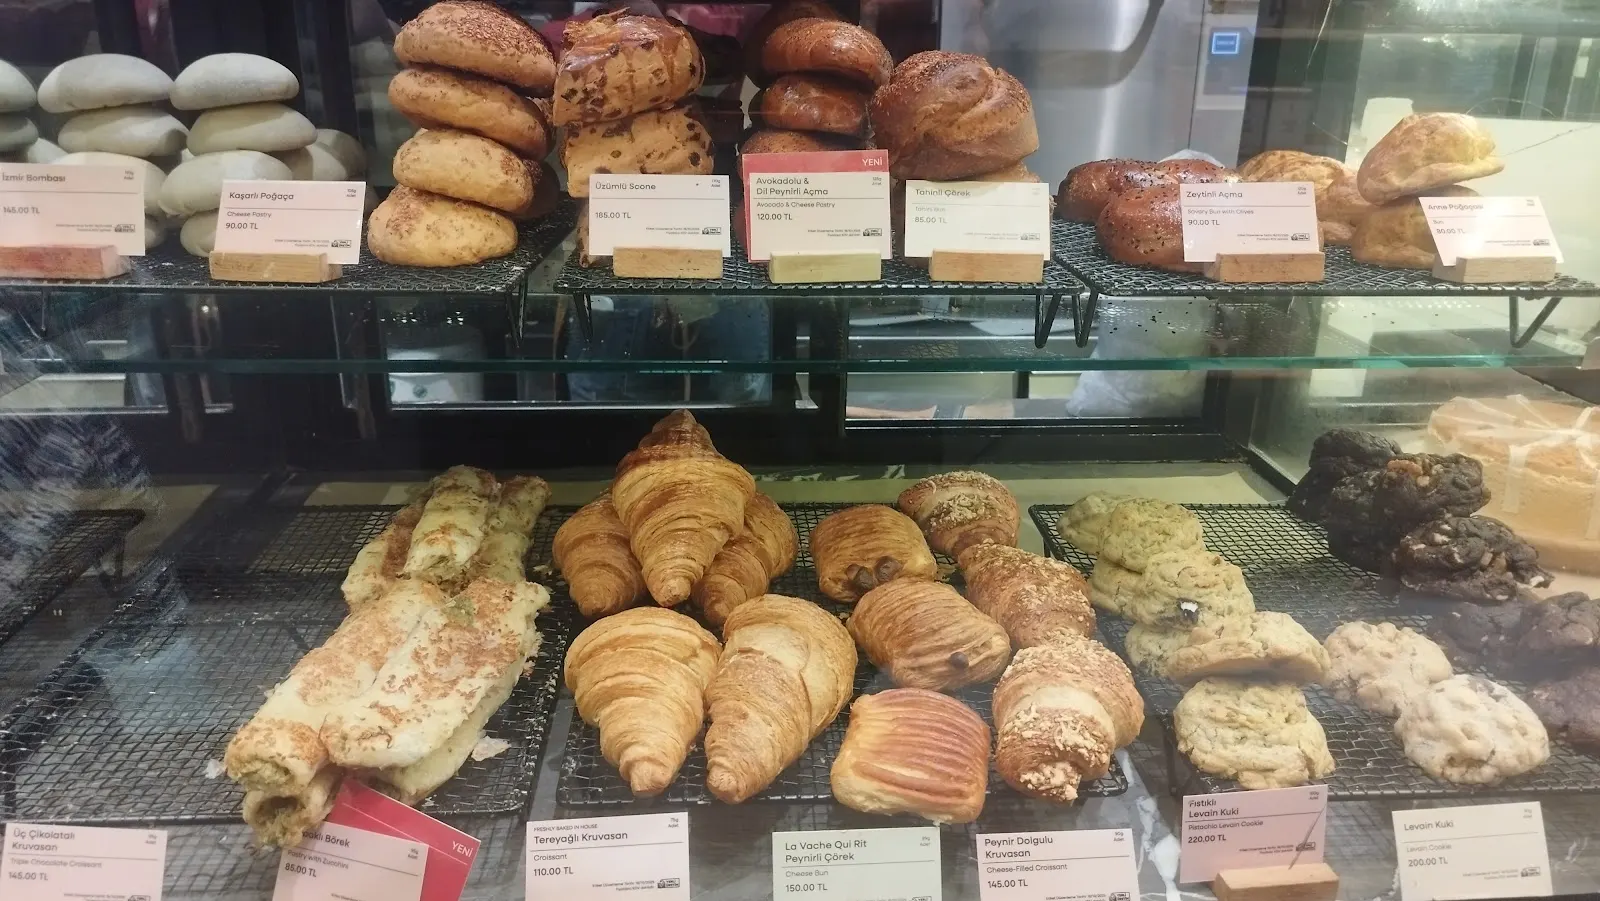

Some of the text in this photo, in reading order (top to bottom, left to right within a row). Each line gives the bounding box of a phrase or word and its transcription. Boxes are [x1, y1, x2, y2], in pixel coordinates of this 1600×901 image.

[862, 157, 882, 166] YENİ
[26, 174, 66, 182] Bombası
[770, 187, 800, 196] Peynirli
[803, 188, 828, 196] Açma
[944, 189, 971, 198] Çörek
[229, 192, 294, 201] Kaşarlı Poğaça
[3, 206, 40, 214] 145.00 TL
[1189, 808, 1239, 818] Levain Kuki
[1404, 820, 1454, 831] Levain Kuki
[14, 828, 75, 840] Üç Çikolatalı
[534, 832, 628, 844] Tereyağlı Kruvasan
[324, 834, 351, 848] Börek
[984, 836, 1053, 847] Peynir Dolgulu
[1188, 835, 1216, 844] 220.00
[12, 842, 58, 851] Kruvasan
[785, 839, 867, 850] La Vache Qui Rit
[452, 841, 474, 858] YENİ
[786, 853, 855, 864] Peynirli Çörek
[985, 850, 1030, 859] Kruvasan
[288, 850, 307, 860] Pastry
[322, 858, 349, 869] Zucchini
[1408, 858, 1436, 867] 200.00
[285, 863, 317, 877] 85.00 TL
[534, 867, 561, 876] 110.00
[986, 864, 1034, 874] Cheese-Filled
[8, 871, 48, 881] 145.00 TL
[786, 883, 815, 892] 150.00
[988, 880, 1016, 888] 145.00
